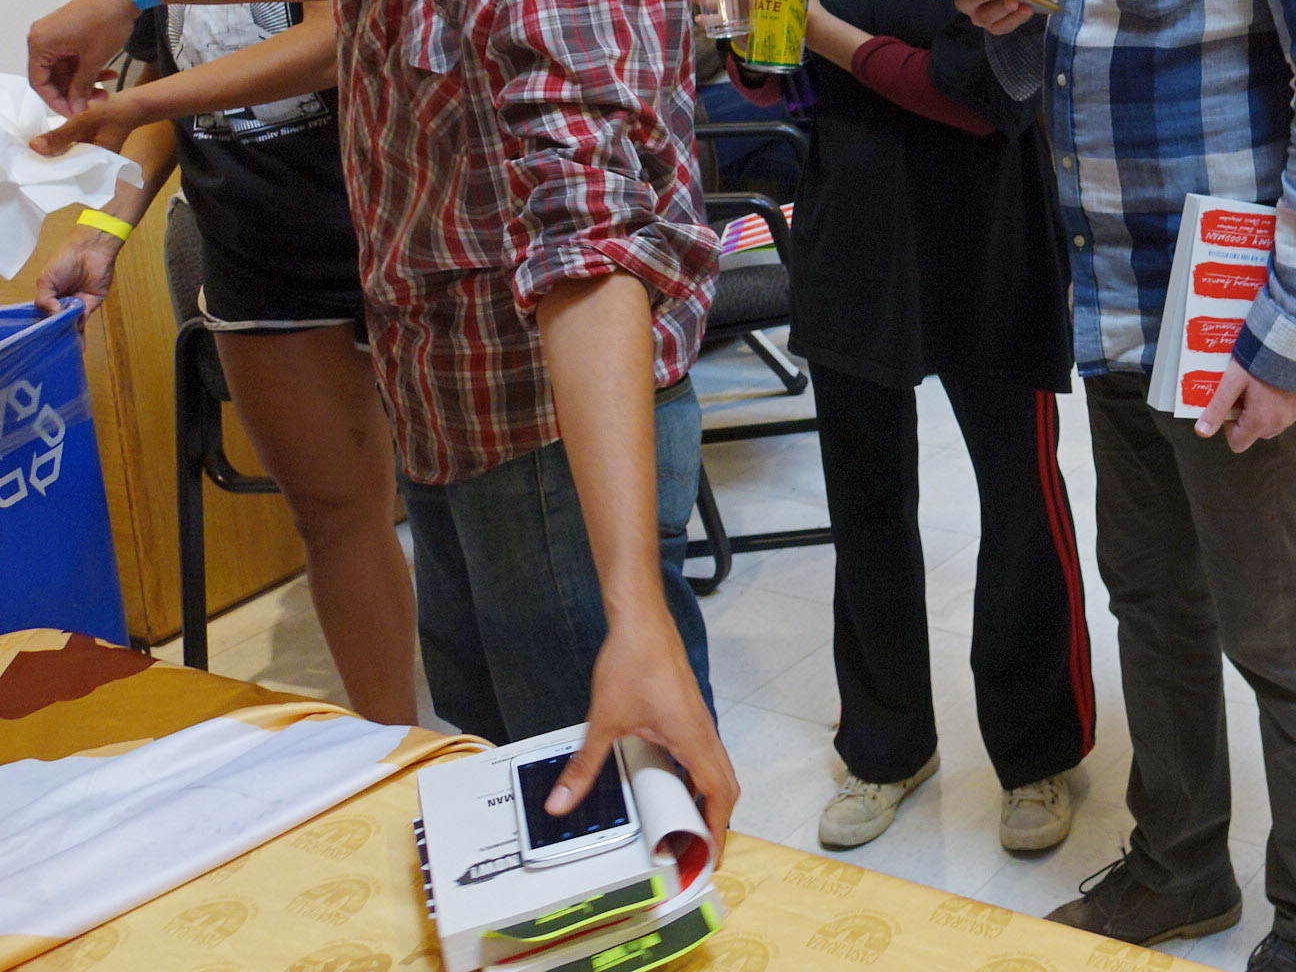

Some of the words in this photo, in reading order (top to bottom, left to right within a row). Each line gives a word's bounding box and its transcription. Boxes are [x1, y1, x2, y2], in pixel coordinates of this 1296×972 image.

[1205, 232, 1248, 245] GOODMAN
[1252, 235, 1273, 247] AMY
[1201, 276, 1232, 289] America
